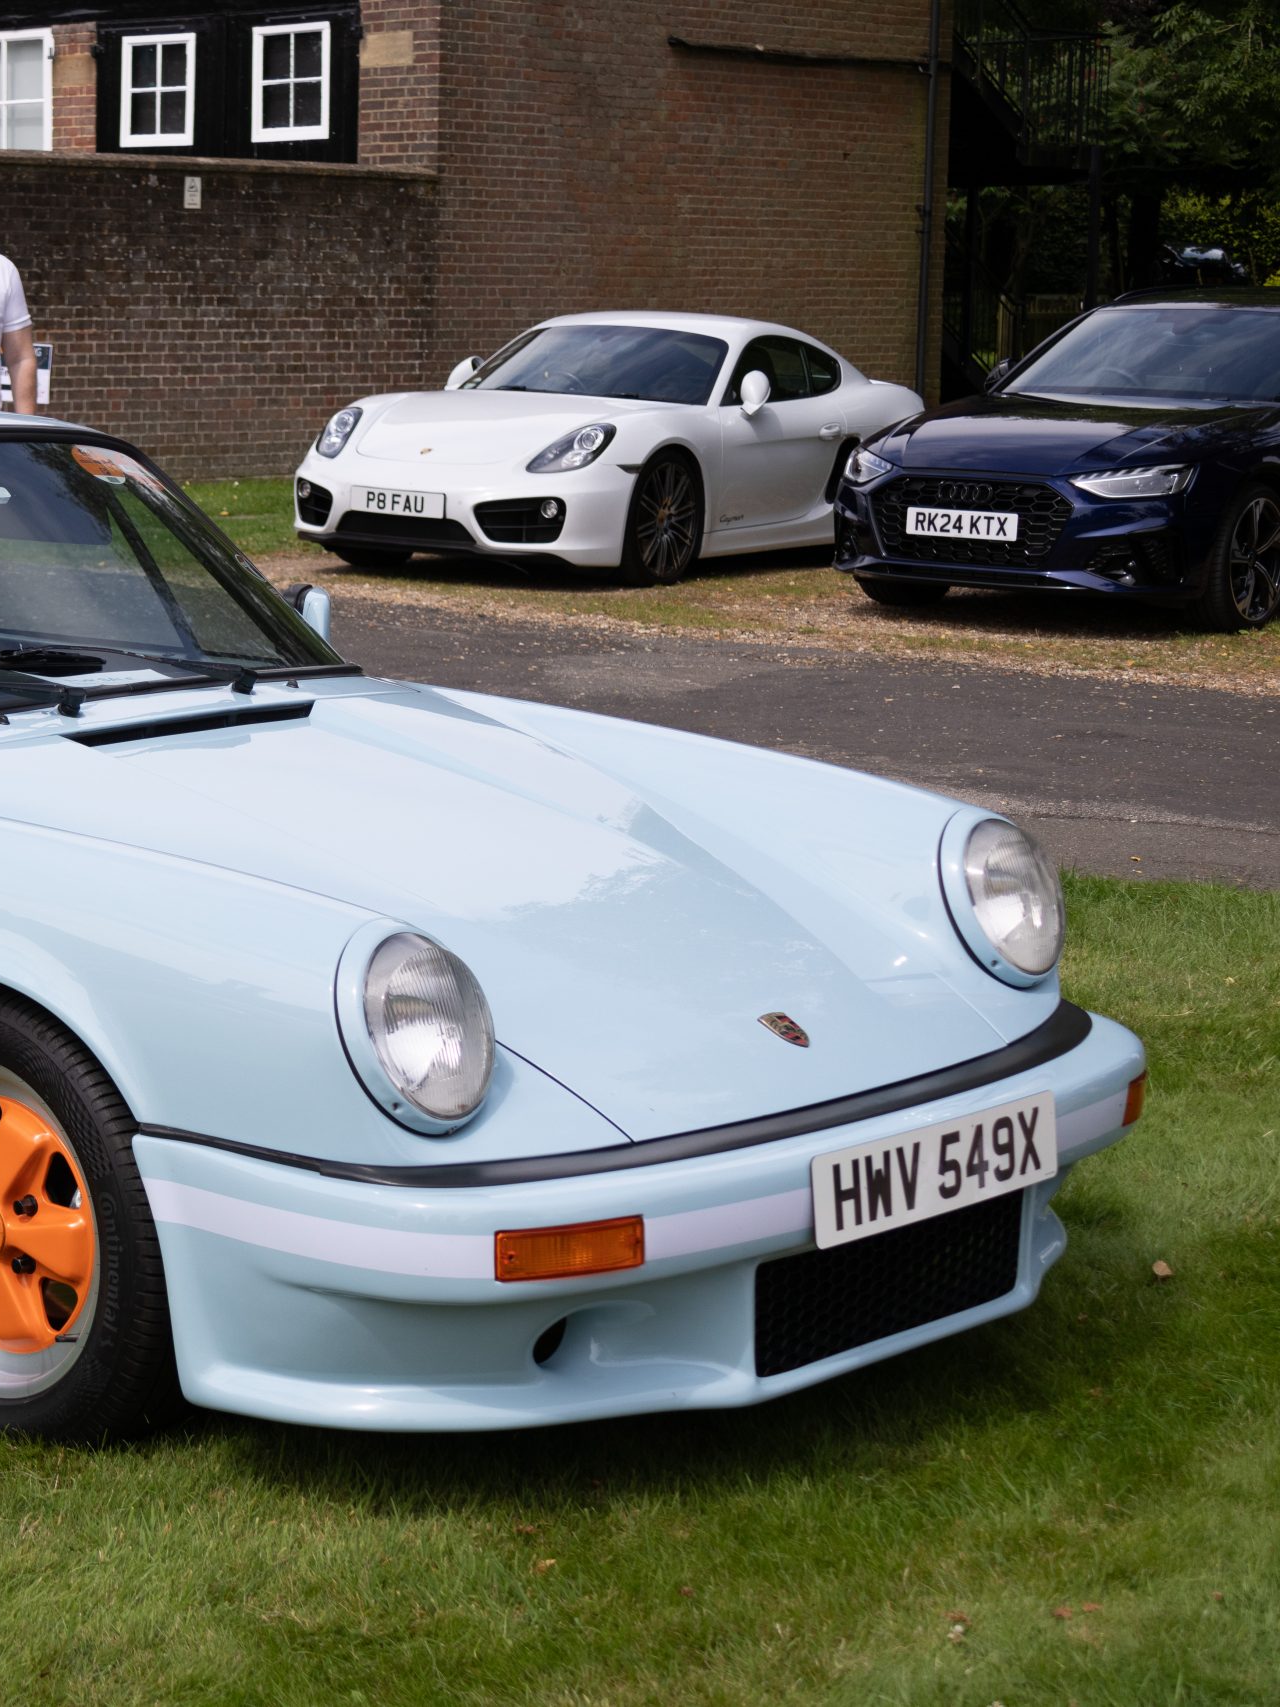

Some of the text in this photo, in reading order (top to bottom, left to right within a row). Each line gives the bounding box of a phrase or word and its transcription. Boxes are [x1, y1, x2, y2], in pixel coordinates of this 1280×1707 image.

[366, 491, 424, 513] P8 FAU
[914, 511, 1008, 537] RK24 KTX
[832, 1106, 1041, 1231] HWV 549X
[100, 1191, 123, 1333] Continental
